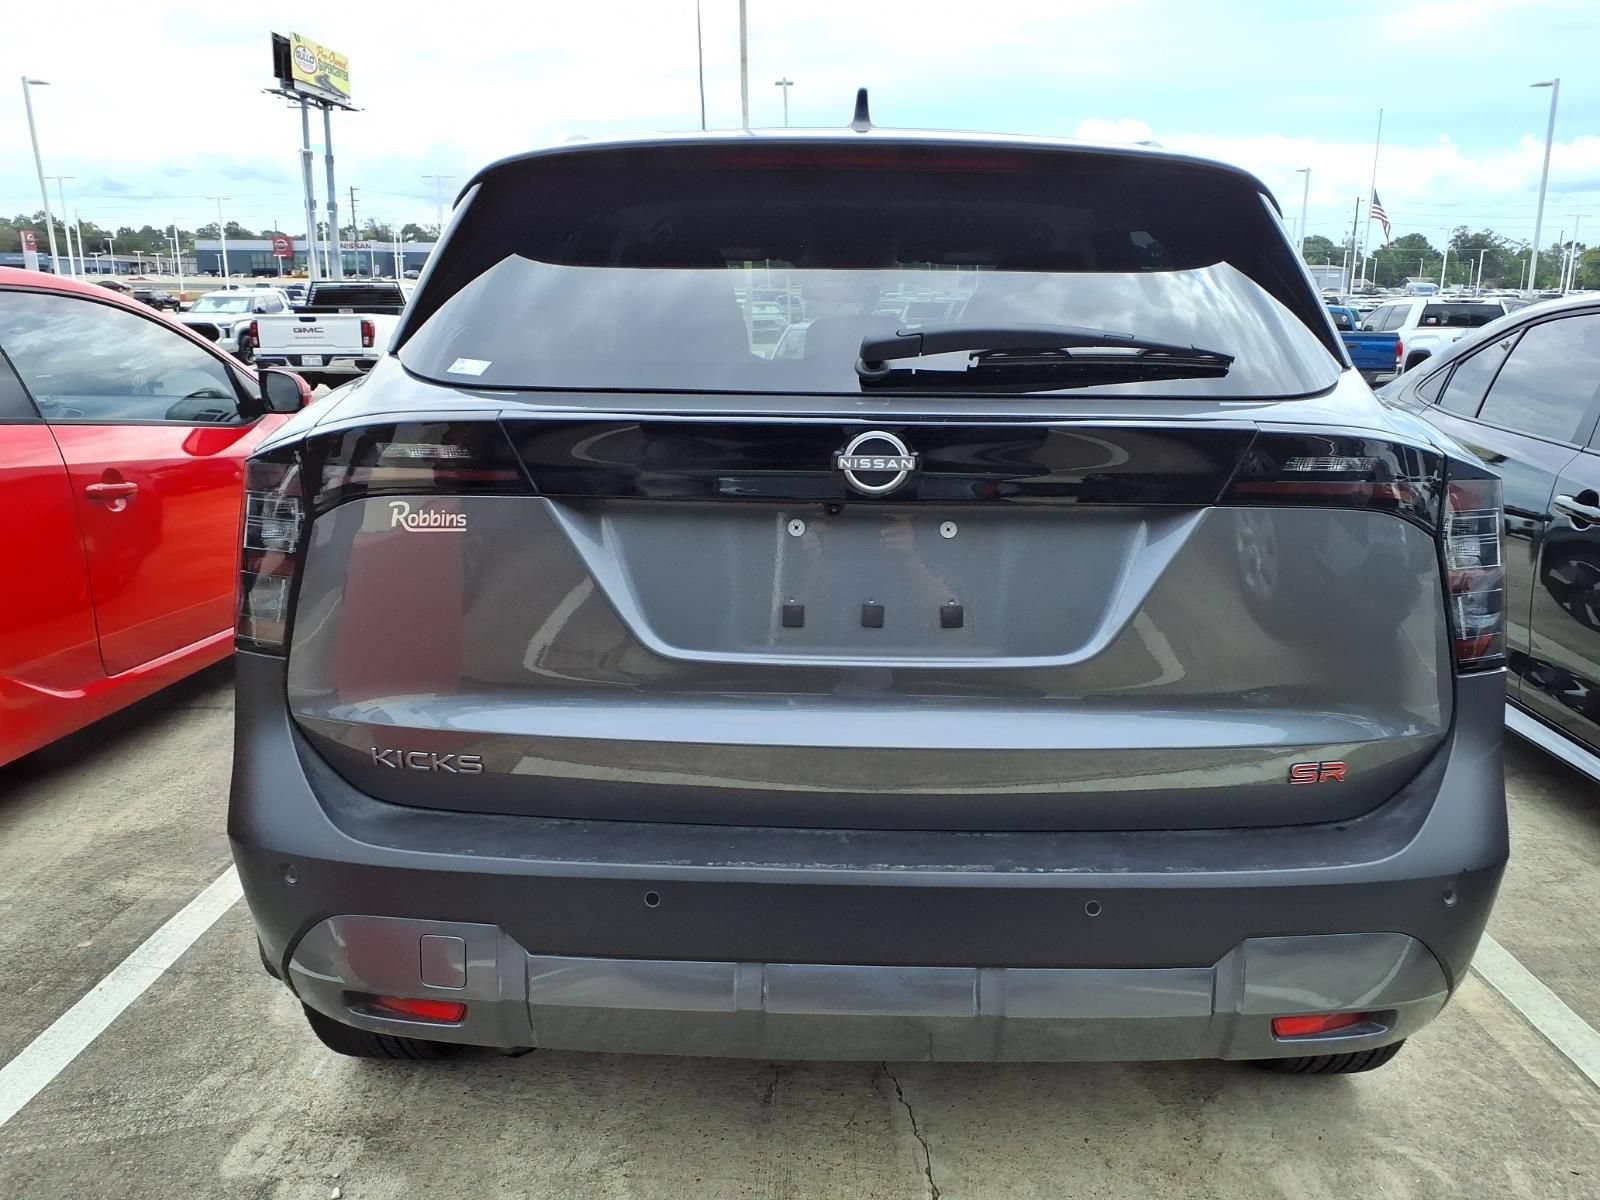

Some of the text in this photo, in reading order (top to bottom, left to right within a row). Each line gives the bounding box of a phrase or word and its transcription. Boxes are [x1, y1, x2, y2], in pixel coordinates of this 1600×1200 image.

[340, 242, 372, 250] NISSAN
[838, 458, 914, 469] NISSAN
[388, 500, 468, 532] Robbins
[371, 747, 484, 774] KICKS
[1289, 760, 1347, 785] SR
